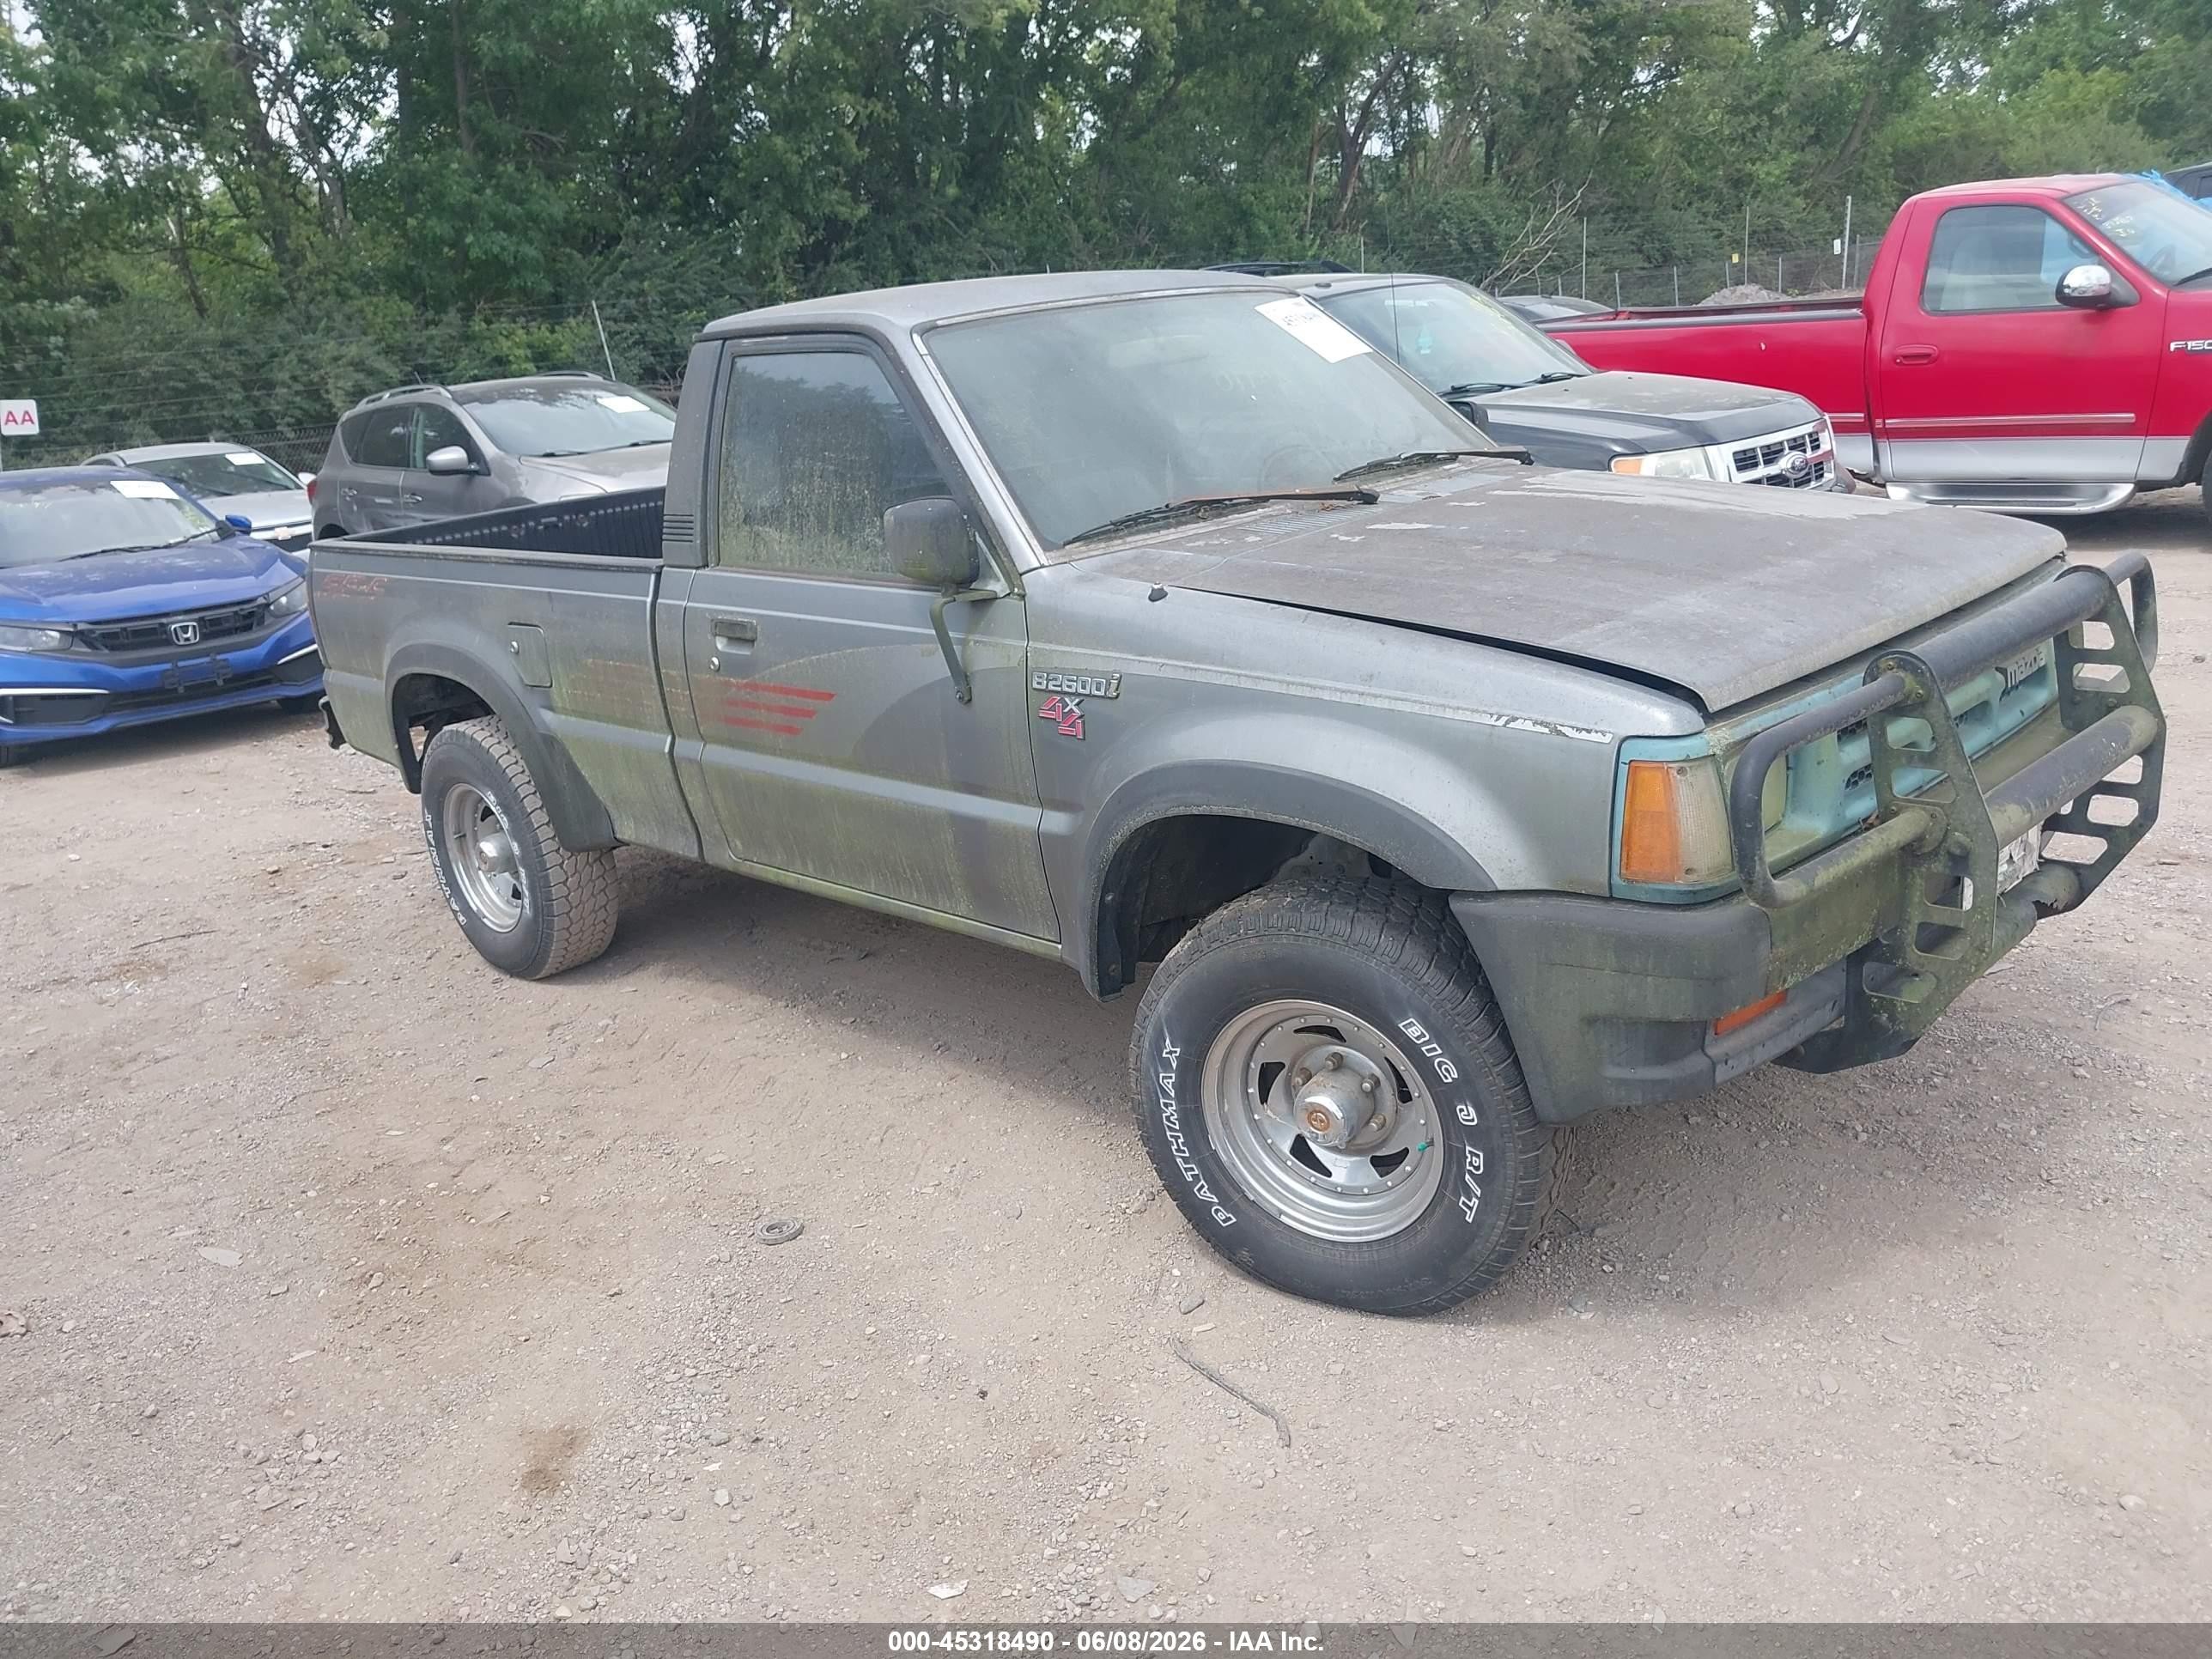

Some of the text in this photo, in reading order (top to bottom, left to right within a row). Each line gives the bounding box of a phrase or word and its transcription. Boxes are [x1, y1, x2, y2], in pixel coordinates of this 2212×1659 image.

[4, 410, 35, 426] AA
[1032, 672, 1121, 699] B2600i
[1159, 1036, 1237, 1227] PATHMAX
[1398, 1018, 1458, 1084] BIG
[1458, 1146, 1484, 1224] R/T
